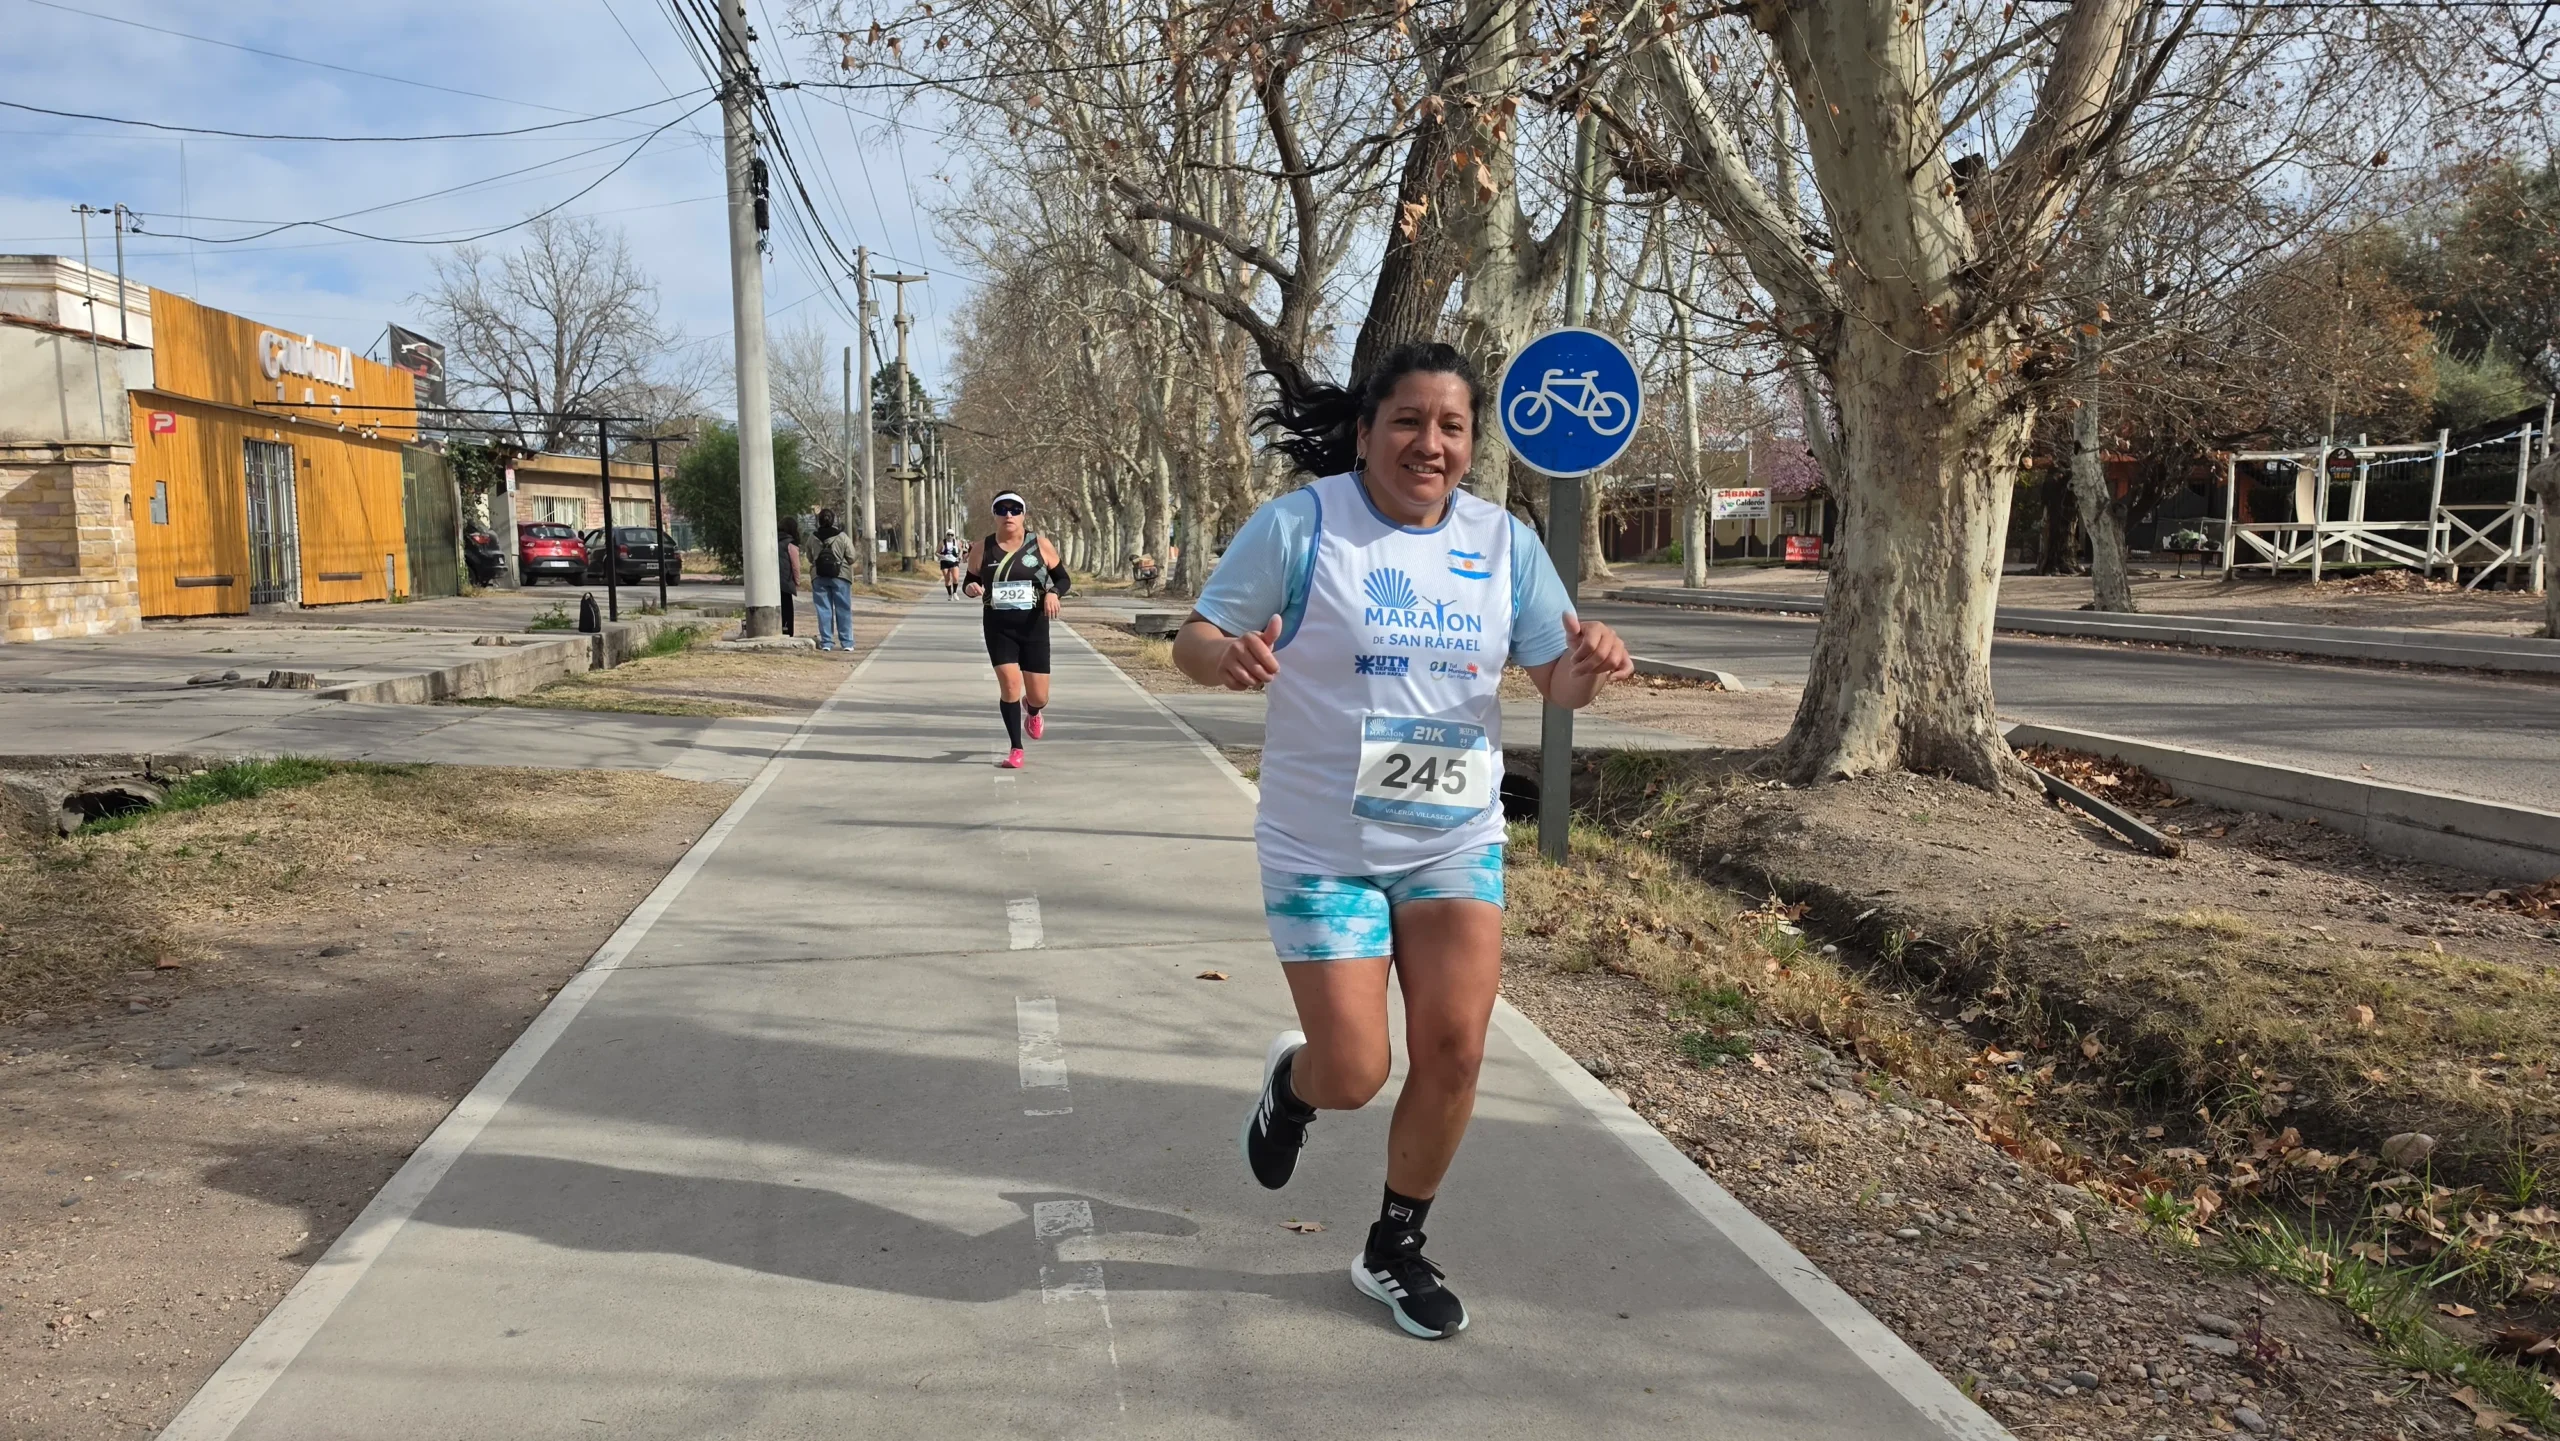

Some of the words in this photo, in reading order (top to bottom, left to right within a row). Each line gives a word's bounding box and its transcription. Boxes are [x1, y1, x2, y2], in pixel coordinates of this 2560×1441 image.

[2338, 449, 2347, 459] 2
[1000, 589, 1025, 600] 292
[1373, 635, 1385, 645] DE
[1389, 633, 1421, 647] SAN
[1425, 635, 1481, 652] RAFAEL
[1376, 655, 1409, 667] UTN
[1413, 726, 1446, 742] 21K
[1380, 753, 1467, 795] 245
[1385, 808, 1415, 817] VALERIA
